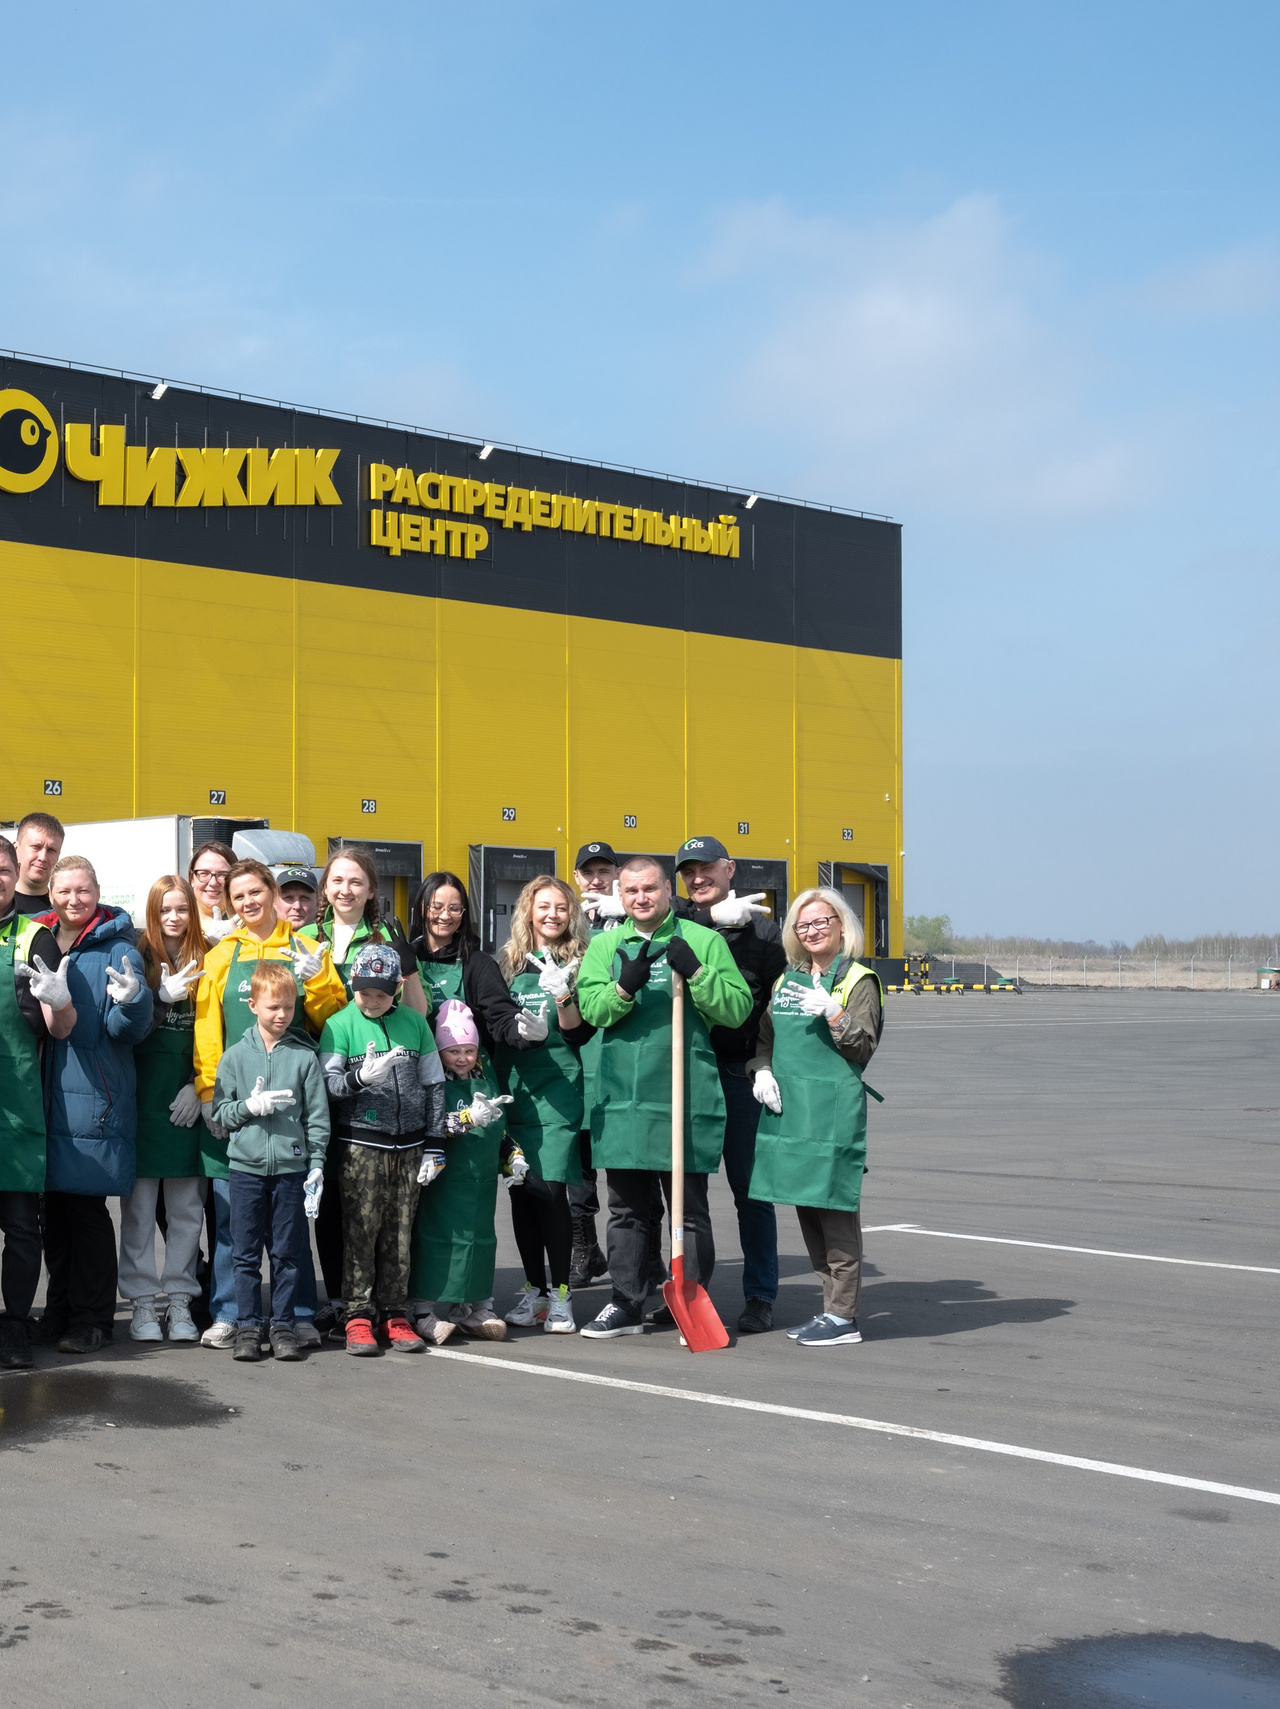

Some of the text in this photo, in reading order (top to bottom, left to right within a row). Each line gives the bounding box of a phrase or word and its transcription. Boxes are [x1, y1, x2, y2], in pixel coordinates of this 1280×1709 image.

[65, 423, 343, 506] Чижик
[370, 462, 741, 558] РАСПРЕДЕЛИТЕЛЬНЫЙ
[370, 508, 489, 559] ЦЕНТР
[45, 780, 61, 795] 26
[210, 790, 225, 804] 27
[362, 799, 376, 813] 28
[502, 808, 516, 821] 29
[624, 815, 636, 828] 30
[739, 823, 748, 833] 31
[843, 829, 852, 839] 32
[690, 841, 705, 850] X5
